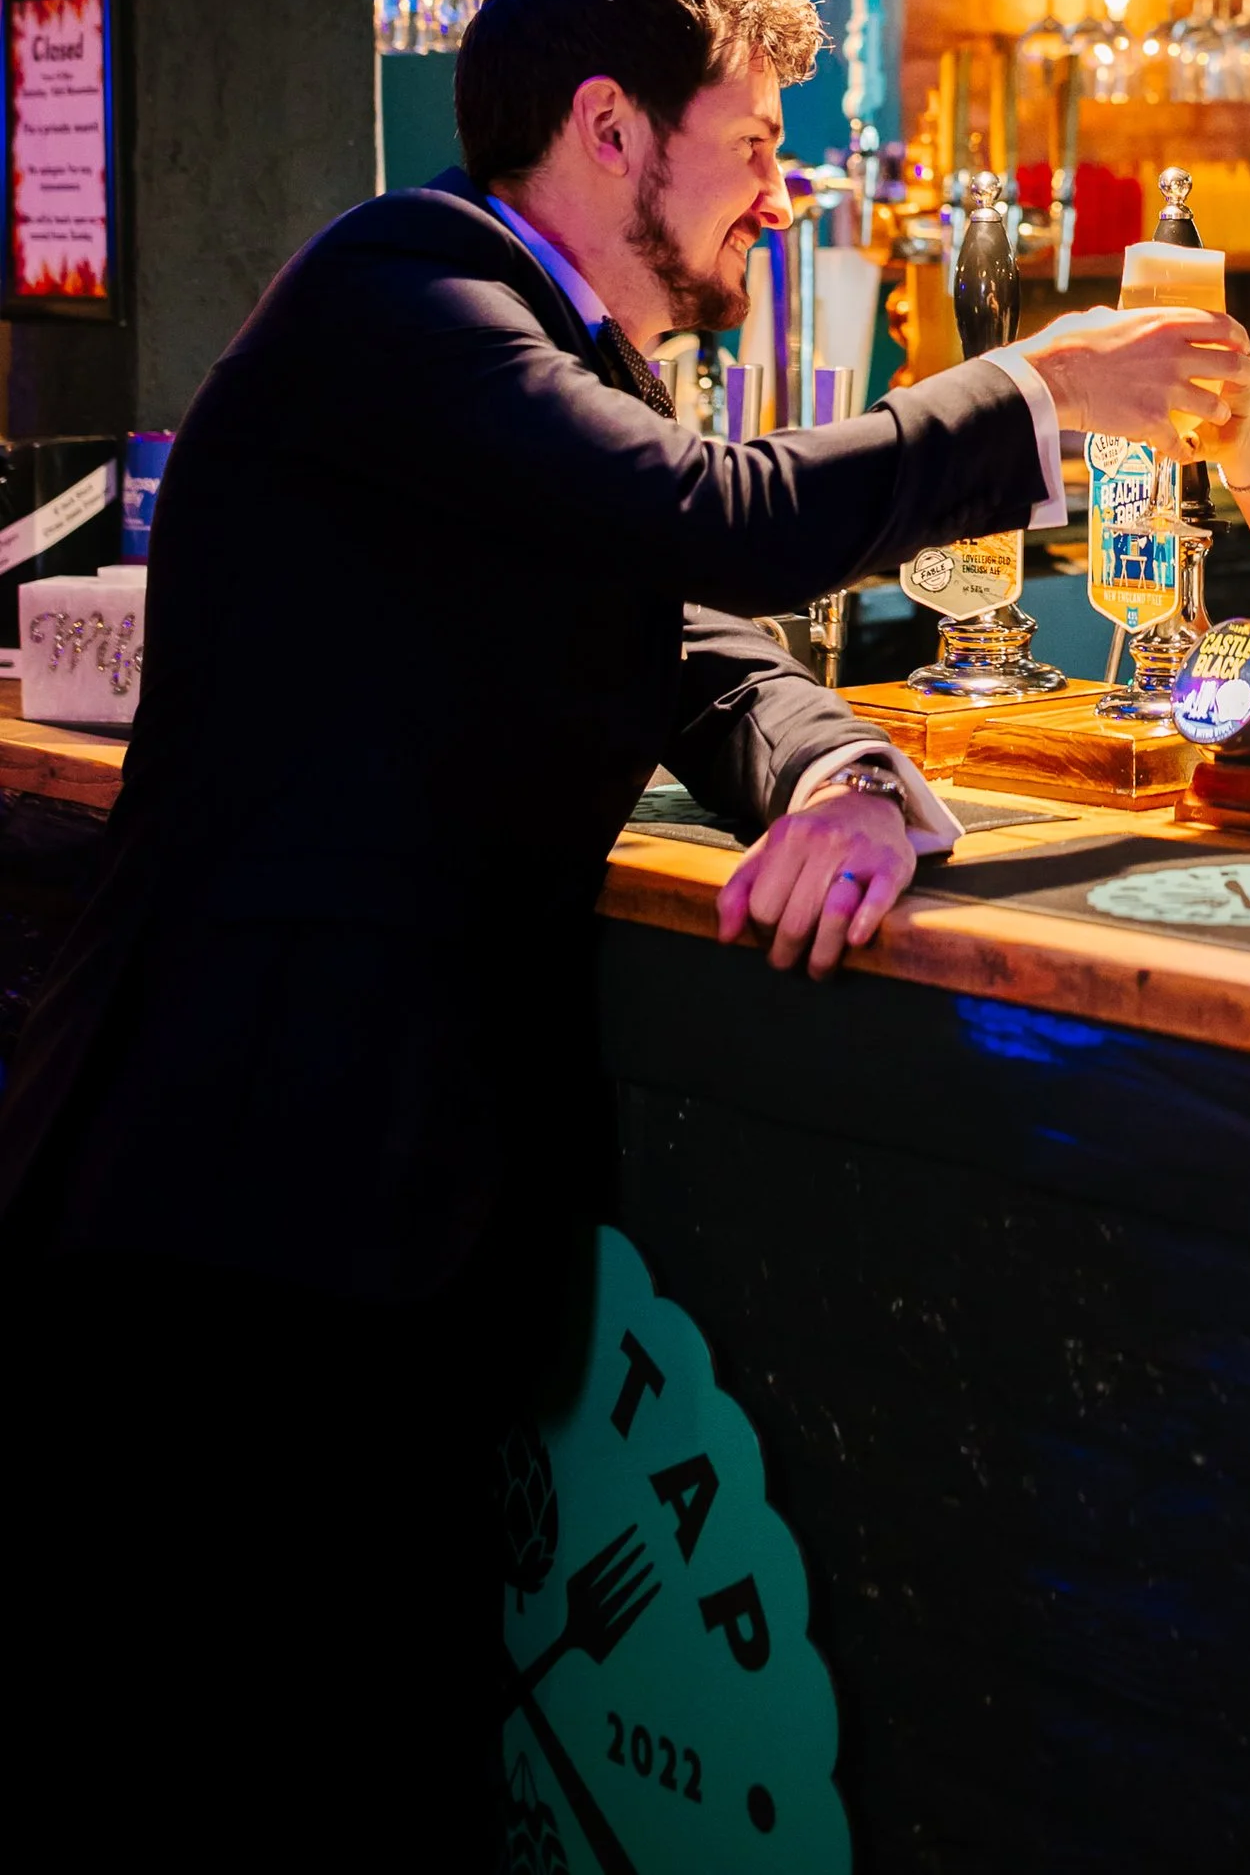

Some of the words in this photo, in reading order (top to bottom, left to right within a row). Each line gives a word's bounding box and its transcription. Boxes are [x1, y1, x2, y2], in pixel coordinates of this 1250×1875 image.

[31, 33, 84, 62] Closed
[1095, 435, 1120, 453] LEIGH
[1101, 479, 1140, 509] BEACH
[920, 563, 946, 580] FABLE
[962, 564, 988, 575] ENGLISH
[989, 566, 1001, 576] ALE
[999, 556, 1011, 566] OLD
[1103, 589, 1117, 602] NEW
[1117, 590, 1146, 604] ENGLAND
[1191, 653, 1247, 680] BLACK
[610, 1328, 771, 1673] TAP
[606, 1711, 703, 1804] 2022
